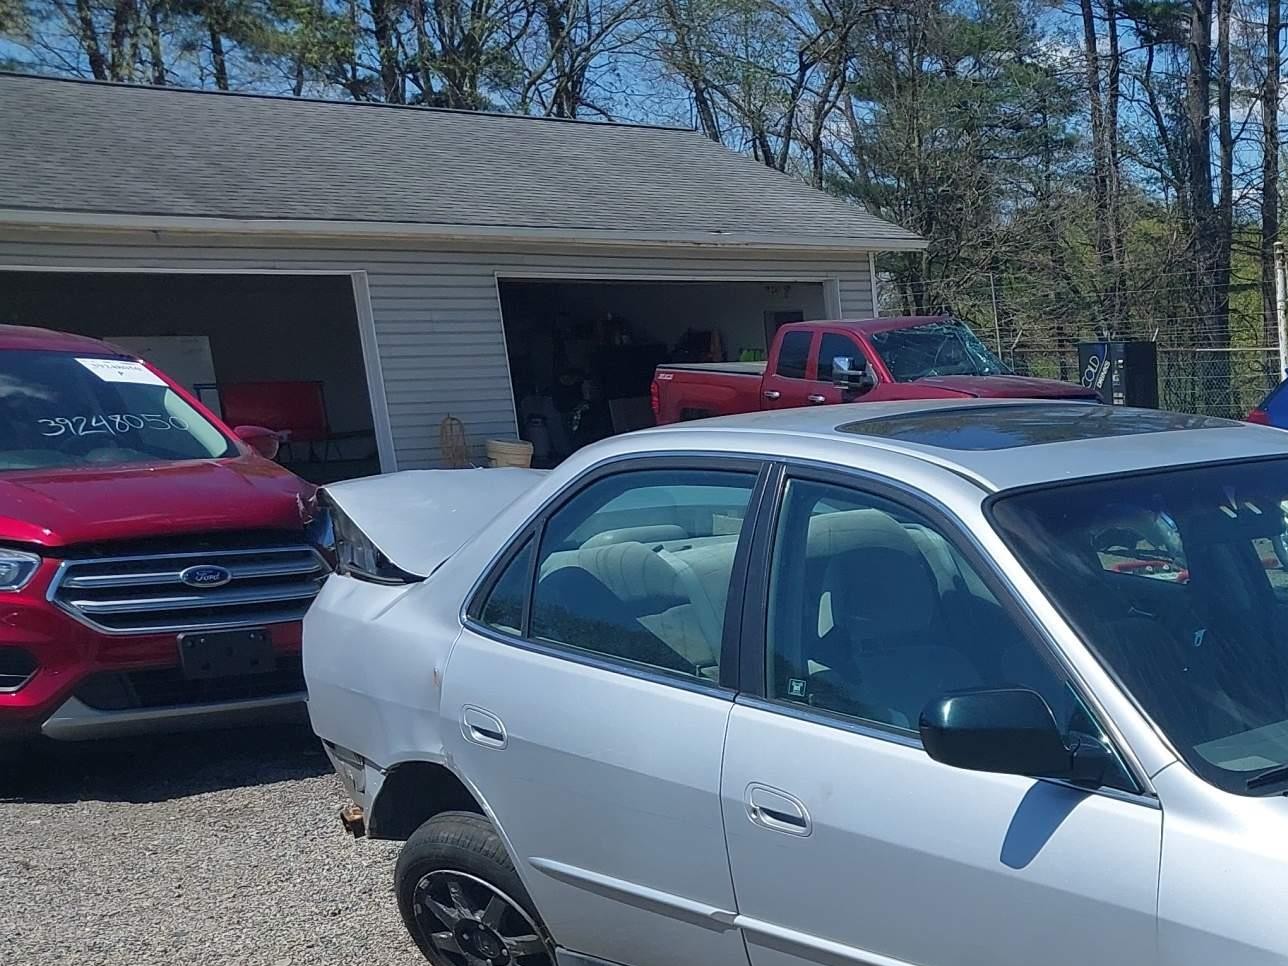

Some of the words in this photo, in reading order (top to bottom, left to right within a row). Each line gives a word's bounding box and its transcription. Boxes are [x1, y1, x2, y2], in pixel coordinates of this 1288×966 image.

[1081, 355, 1100, 389] COLD
[1096, 359, 1111, 389] DRINKS
[37, 414, 189, 437] 39248050
